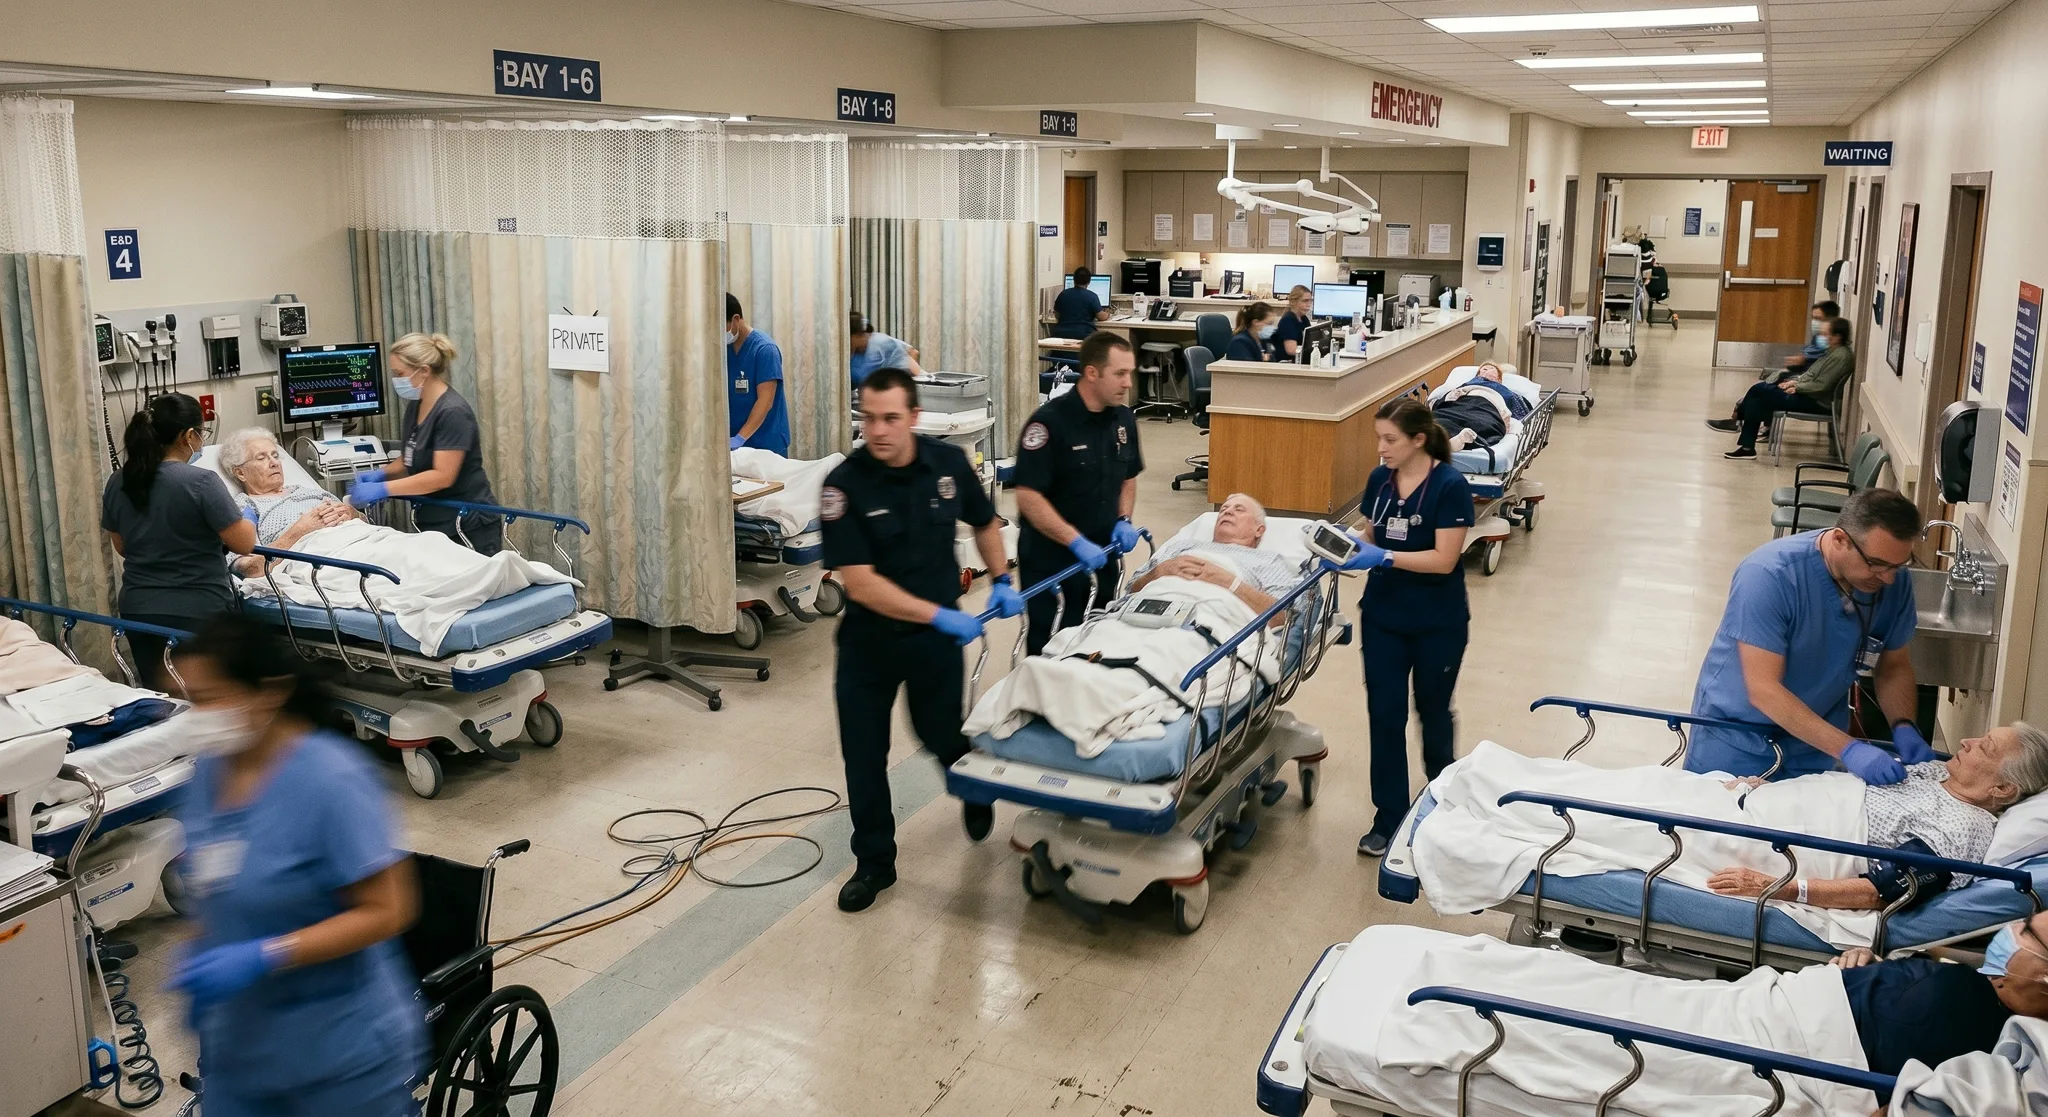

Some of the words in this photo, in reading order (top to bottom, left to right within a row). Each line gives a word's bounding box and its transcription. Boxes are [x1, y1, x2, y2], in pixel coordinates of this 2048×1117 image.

[503, 60, 549, 89] BAY
[560, 66, 594, 94] 1-6
[842, 95, 868, 116] BAY
[873, 99, 892, 119] 1-8
[1371, 81, 1443, 128] EMERGENCY
[1043, 114, 1059, 130] BAY
[1062, 117, 1075, 132] 1-8
[1698, 129, 1723, 146] EXIT
[1828, 148, 1888, 160] WAITING
[110, 235, 133, 245] E&D
[115, 249, 133, 272] 4
[553, 328, 605, 352] PRIVATE
